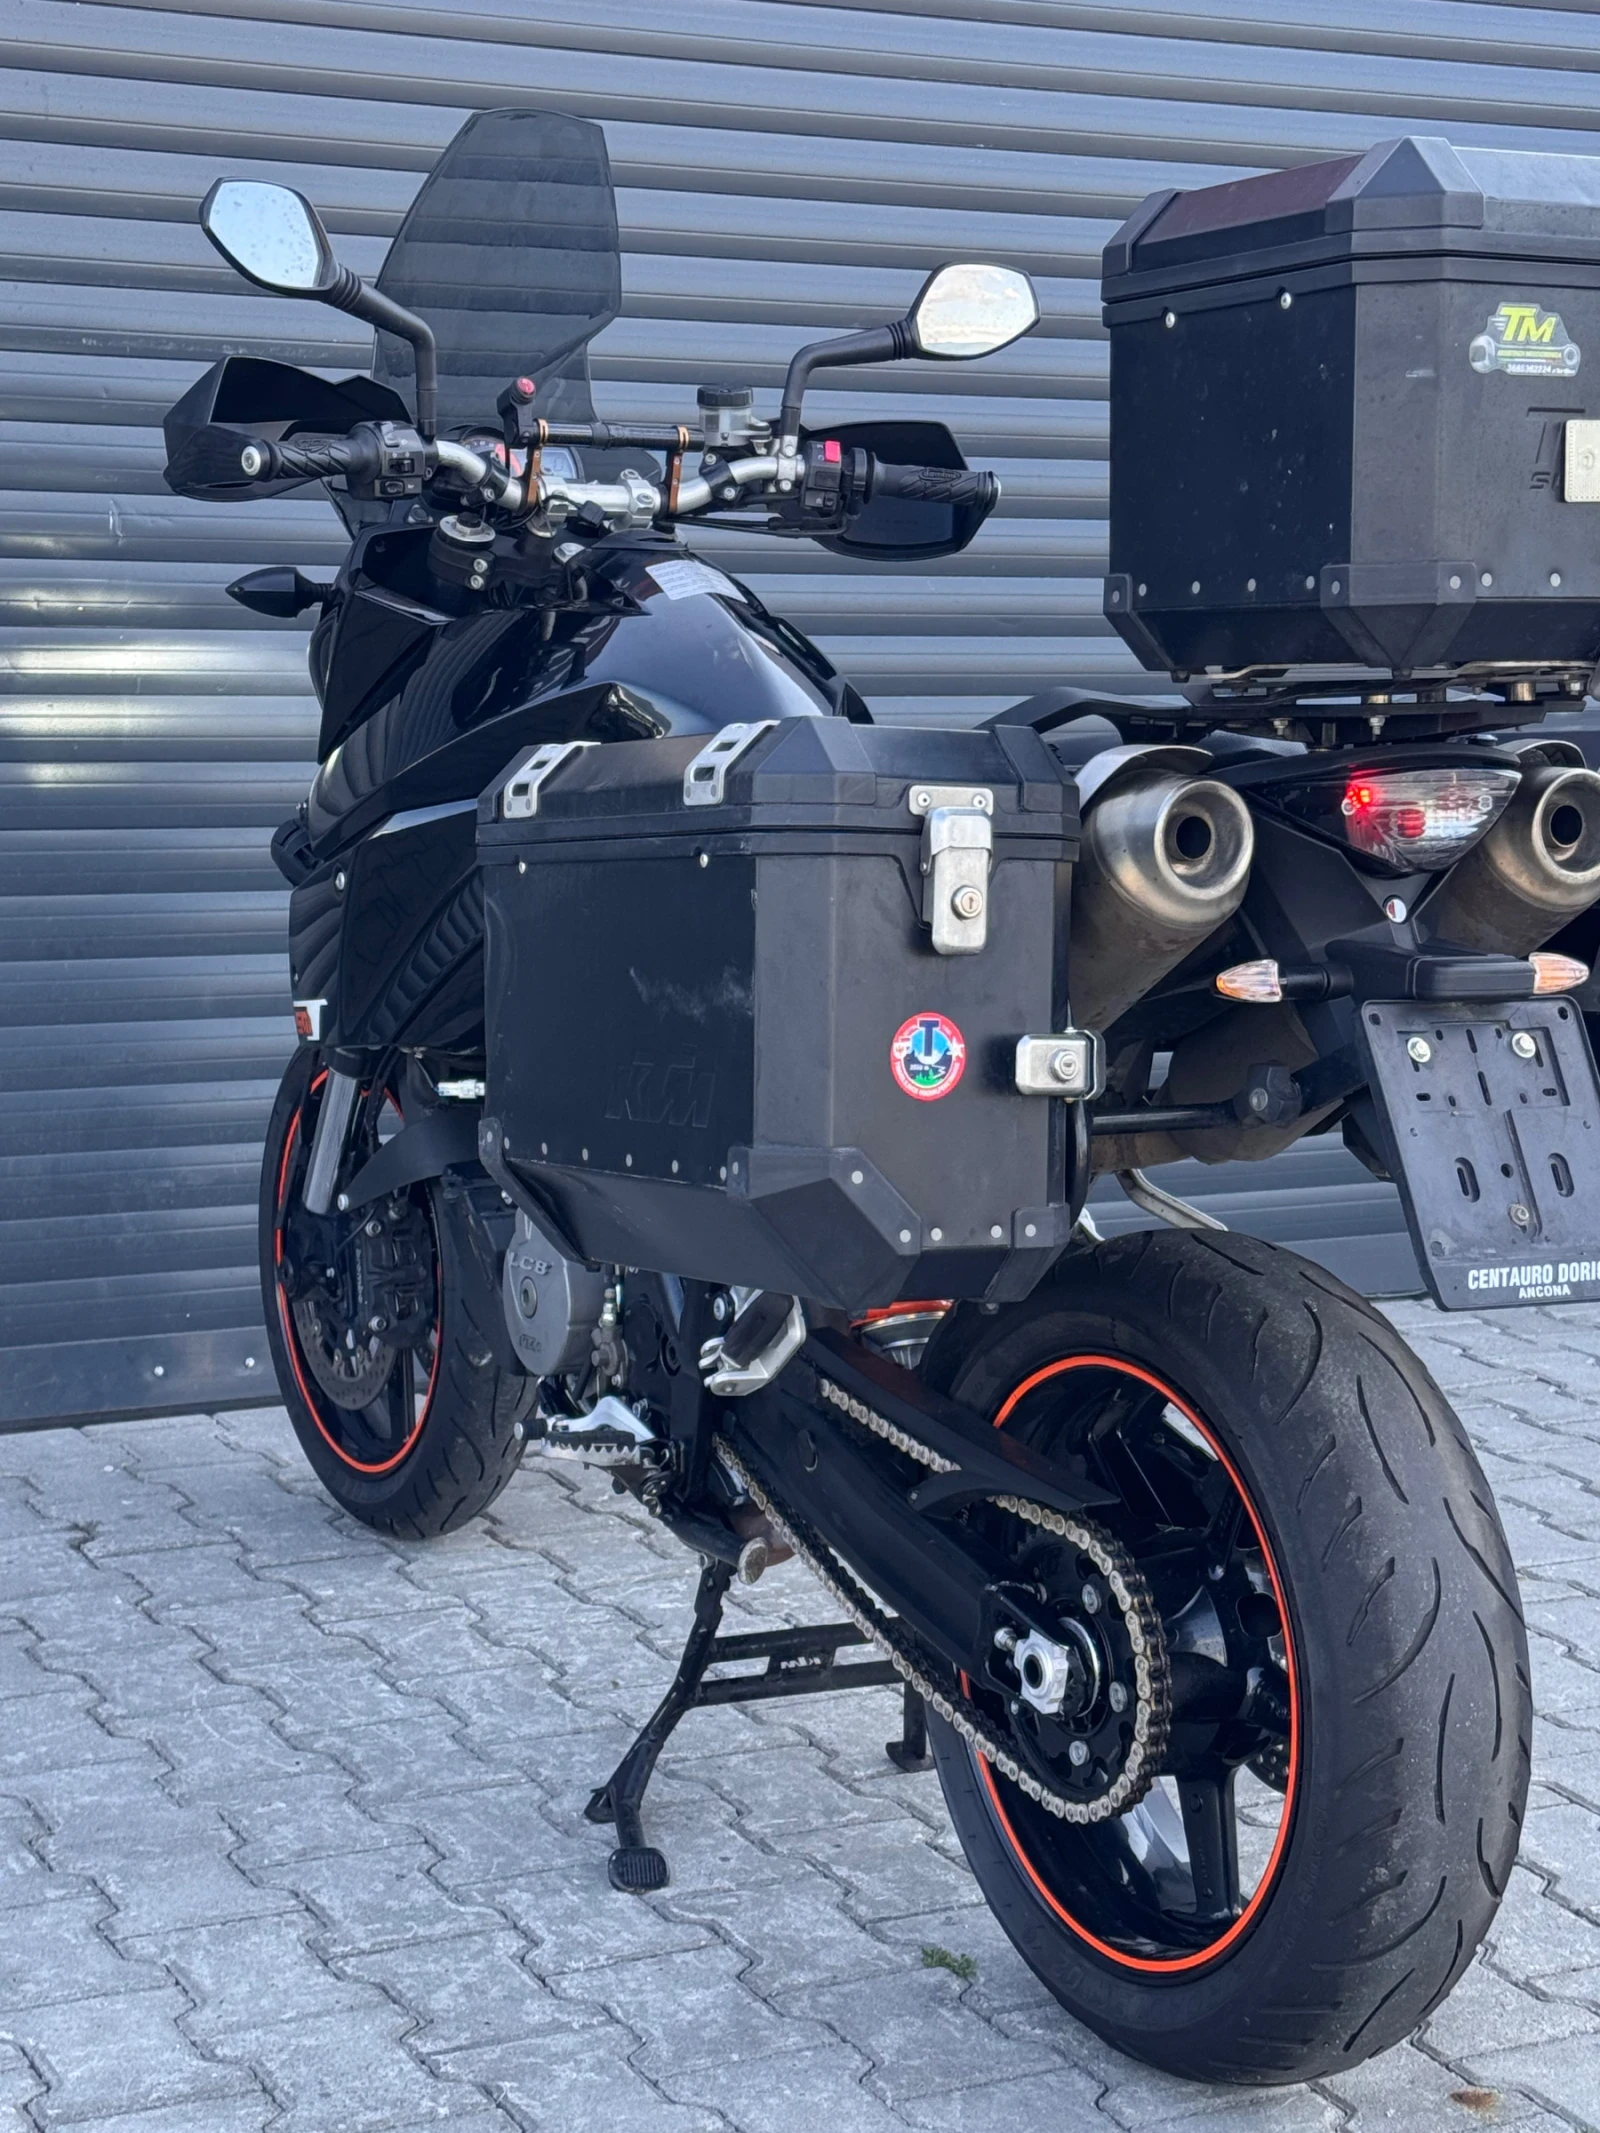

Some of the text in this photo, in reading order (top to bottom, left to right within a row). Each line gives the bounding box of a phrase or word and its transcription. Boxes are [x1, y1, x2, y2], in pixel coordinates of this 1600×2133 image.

[1499, 306, 1557, 342] TM
[1467, 1260, 1600, 1290] CENTAURO DORI
[1518, 1283, 1571, 1299] ANCONA
